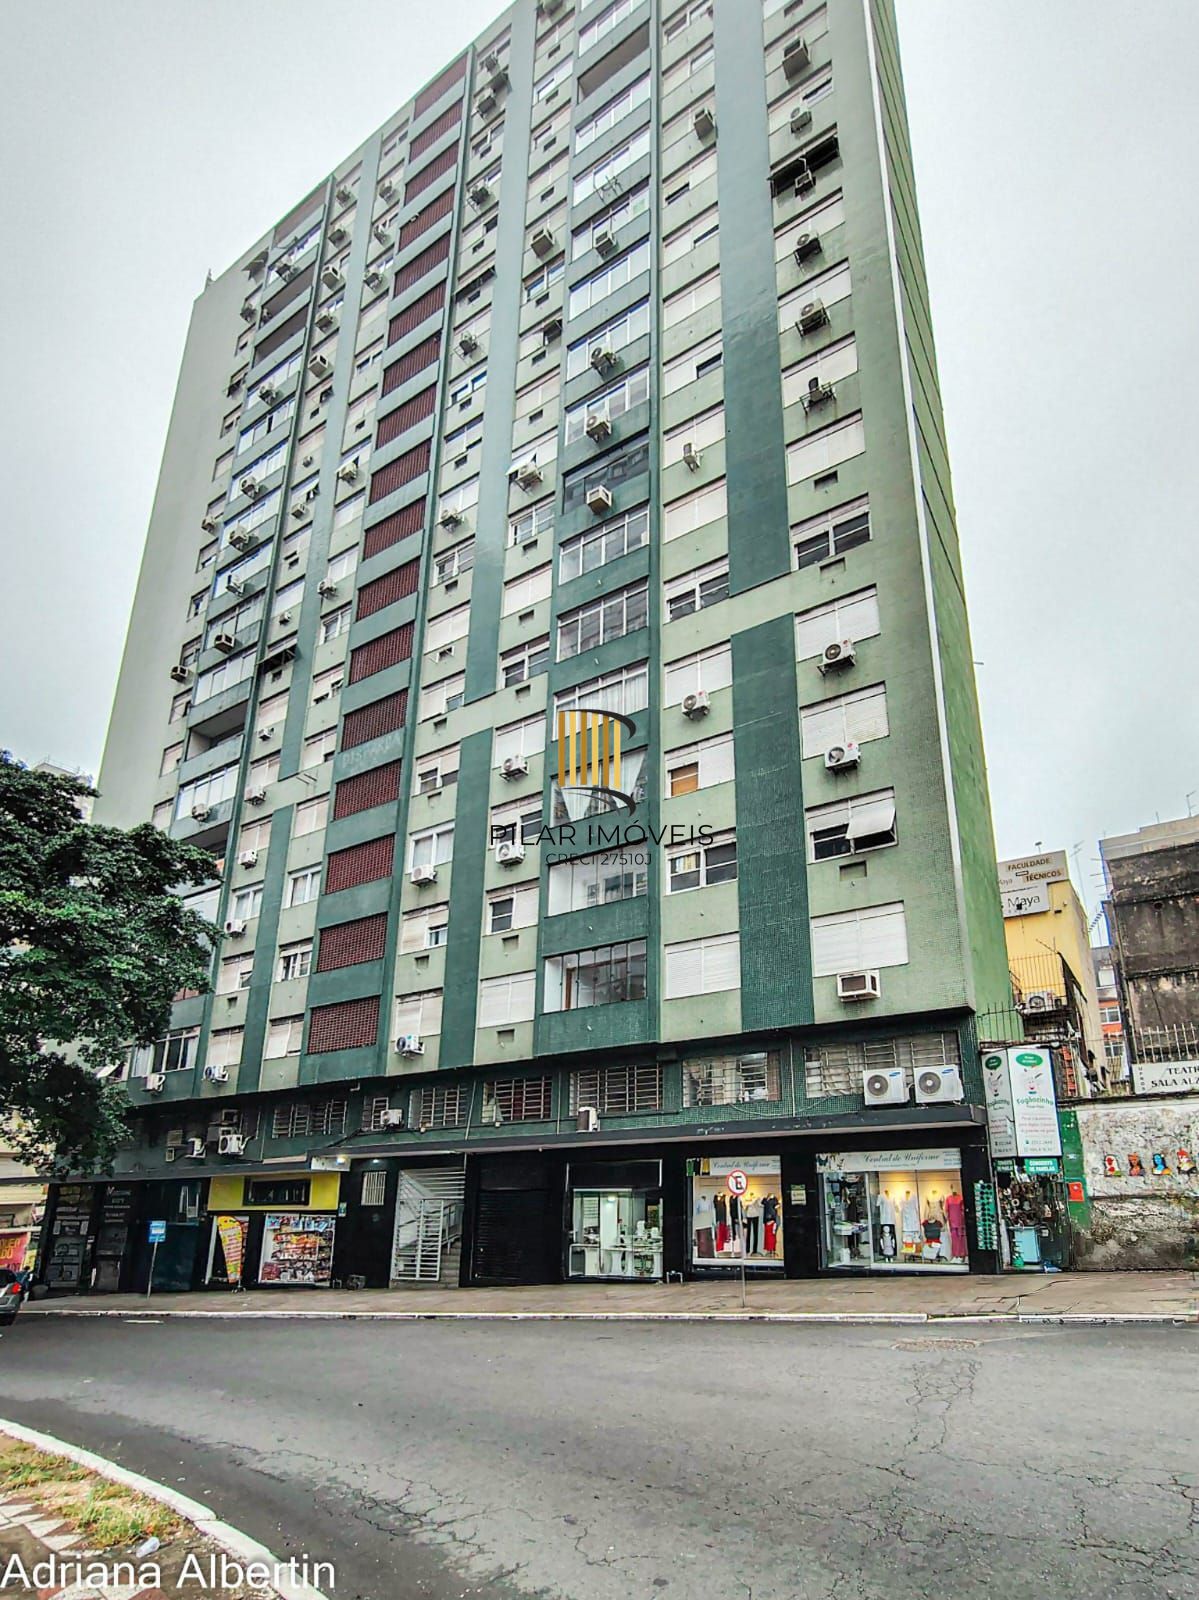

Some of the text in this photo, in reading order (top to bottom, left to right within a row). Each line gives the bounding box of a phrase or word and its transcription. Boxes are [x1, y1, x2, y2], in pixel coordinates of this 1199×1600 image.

[1008, 857, 1051, 871] FACULDADE
[1026, 869, 1062, 882] TÉCNICOS
[1008, 895, 1041, 908] Maya
[1151, 1079, 1178, 1088] SALA
